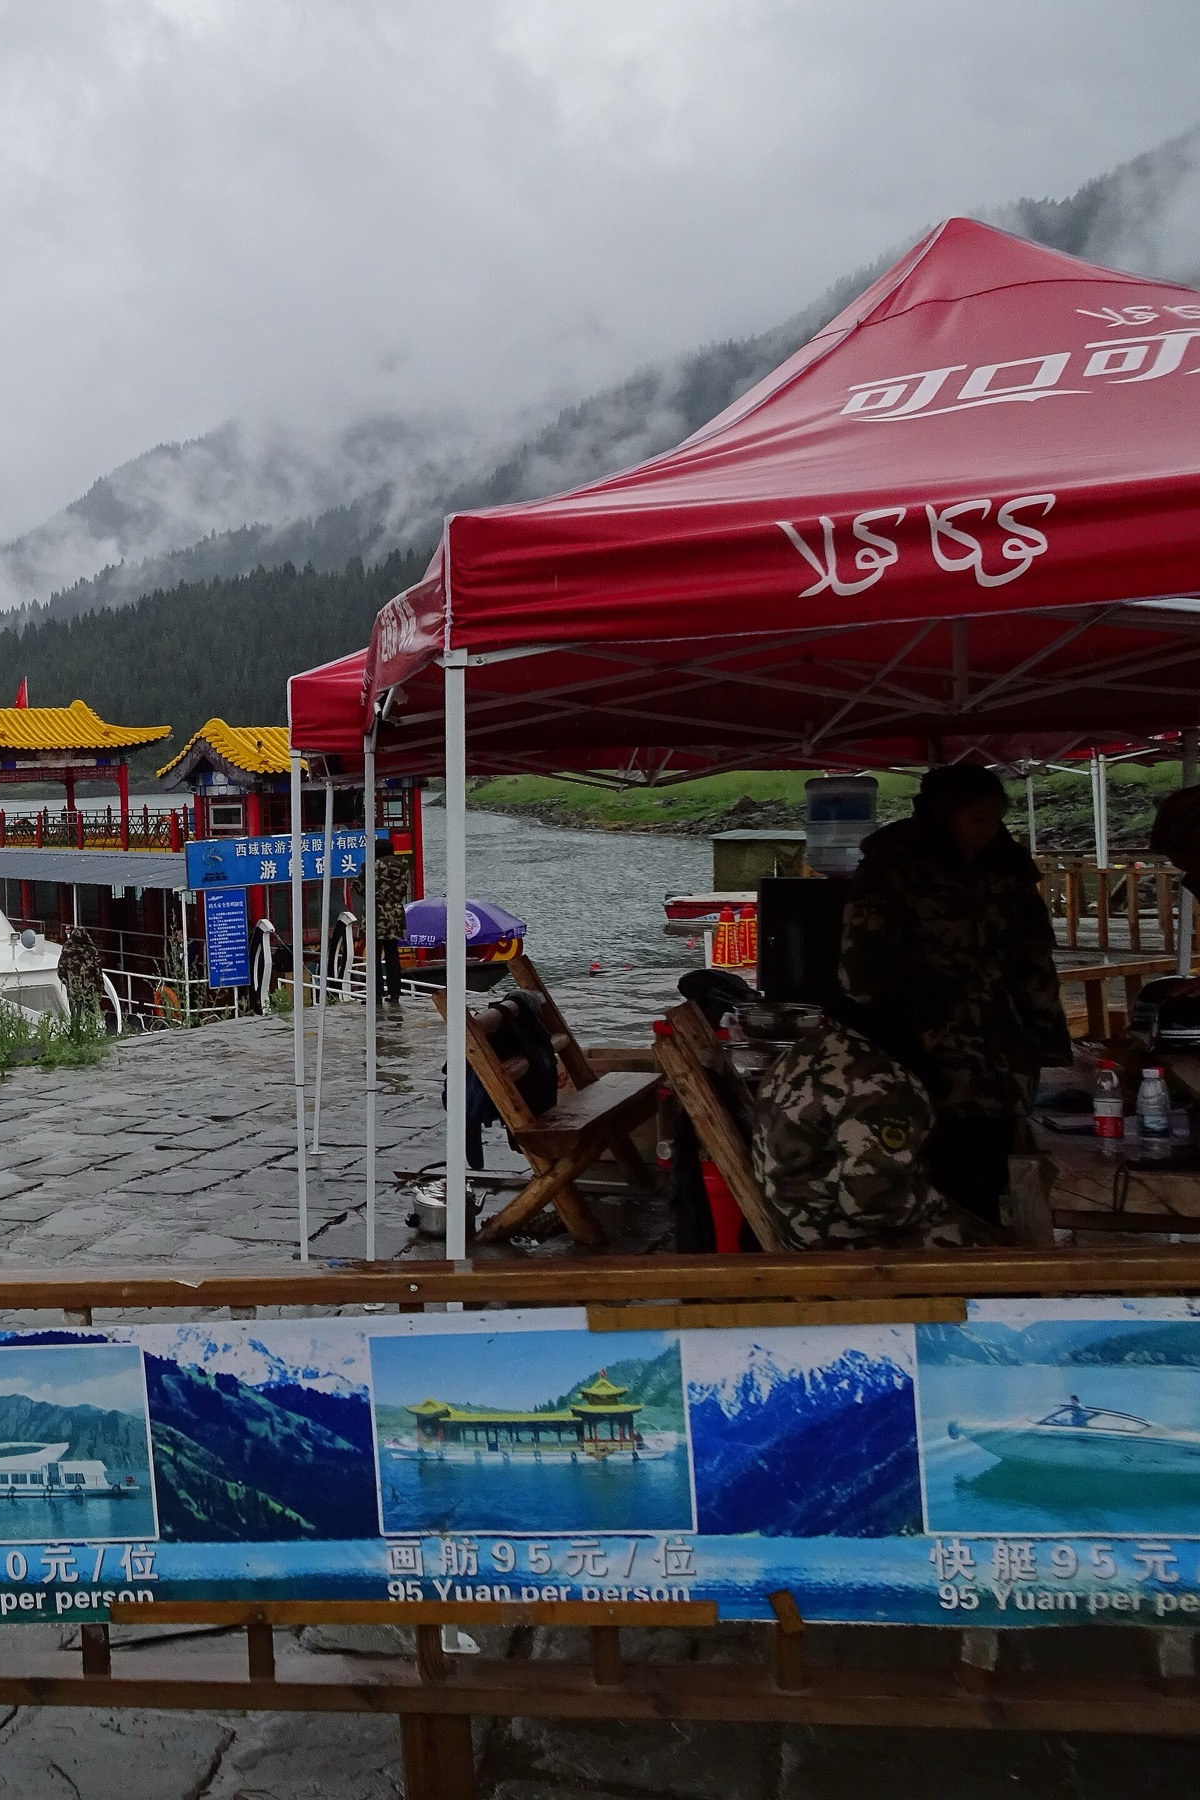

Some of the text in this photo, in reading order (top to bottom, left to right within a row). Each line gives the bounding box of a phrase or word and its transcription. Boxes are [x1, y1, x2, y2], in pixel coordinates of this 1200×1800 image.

[840, 327, 1200, 422] 可口可
[386, 1535, 697, 1578] 画舫95元/位
[929, 1538, 1200, 1583] 快艇95元
[0, 1592, 47, 1615] per
[55, 1589, 154, 1614] person
[387, 1579, 691, 1602] 95 Yuan per person
[938, 1584, 979, 1611] 95
[991, 1583, 1078, 1611] Yuan
[1087, 1591, 1146, 1615] per
